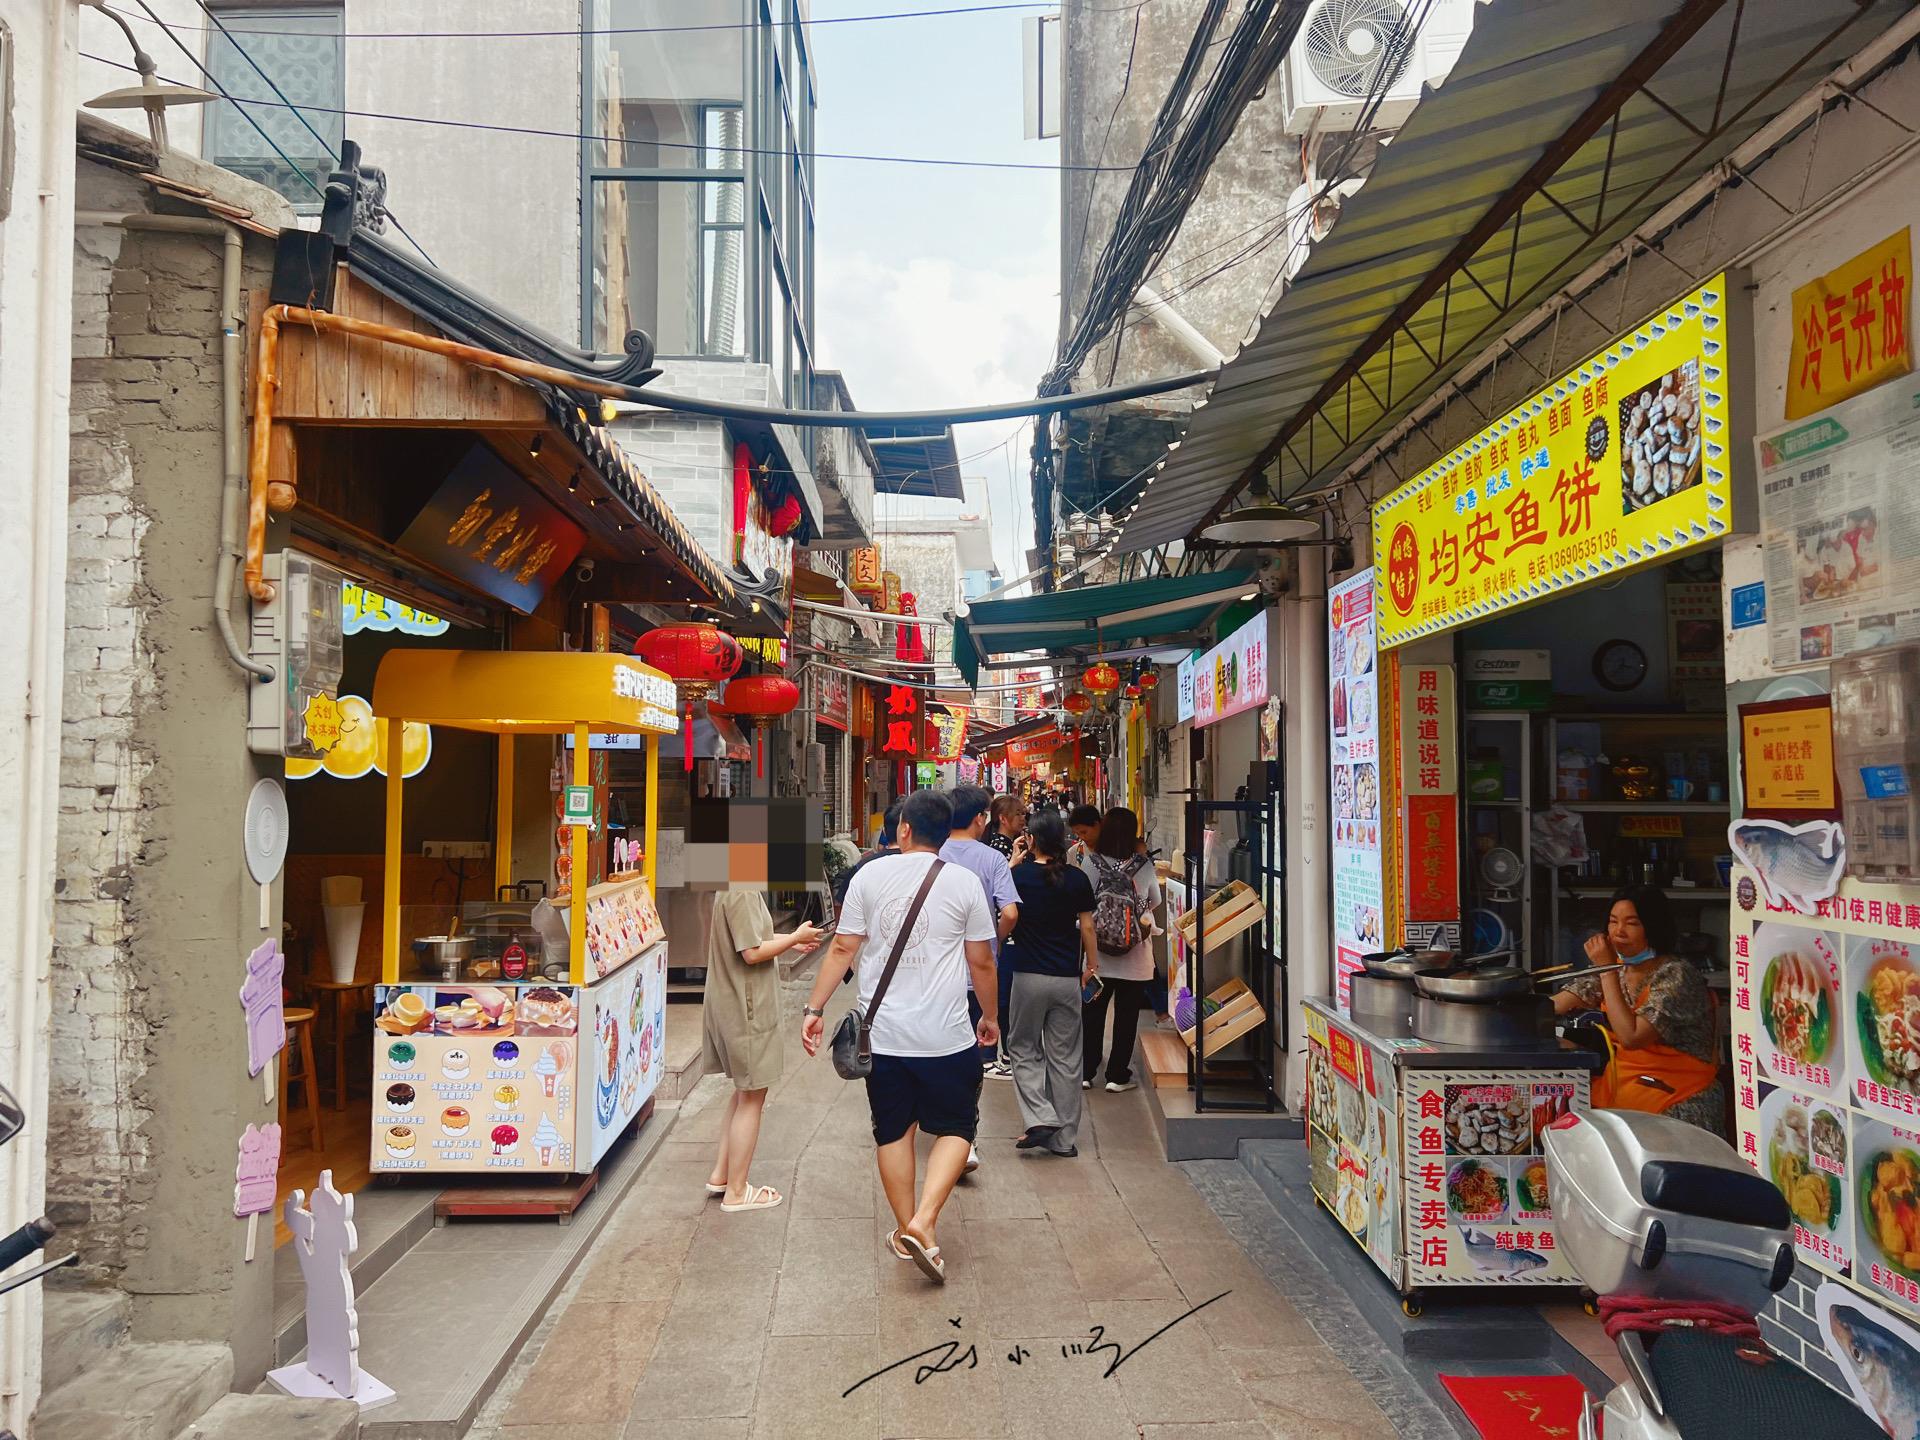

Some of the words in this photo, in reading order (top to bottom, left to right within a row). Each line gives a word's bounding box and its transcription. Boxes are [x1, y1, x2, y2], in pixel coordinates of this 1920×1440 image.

[1800, 257, 1905, 396] 冷气开放
[1442, 470, 1458, 500] 鱼饼
[1489, 438, 1509, 472] 鱼皮
[1517, 421, 1539, 455] 鱼丸
[1547, 398, 1572, 438] 鱼面
[1454, 490, 1478, 516] 零售
[1485, 469, 1512, 499] 批发
[1520, 446, 1550, 479] 快递
[1427, 455, 1601, 588] 均安鱼饼
[313, 704, 333, 719] 文创
[1417, 670, 1441, 790] 用味道说话
[1771, 763, 1806, 782] 示范店
[1736, 934, 1751, 1011] 道可道
[1738, 1032, 1755, 1111] 味可道
[1416, 1088, 1448, 1267] 食鱼专卖店
[1743, 1130, 1758, 1169] 真
[1495, 1231, 1556, 1250] 纯鲮鱼
